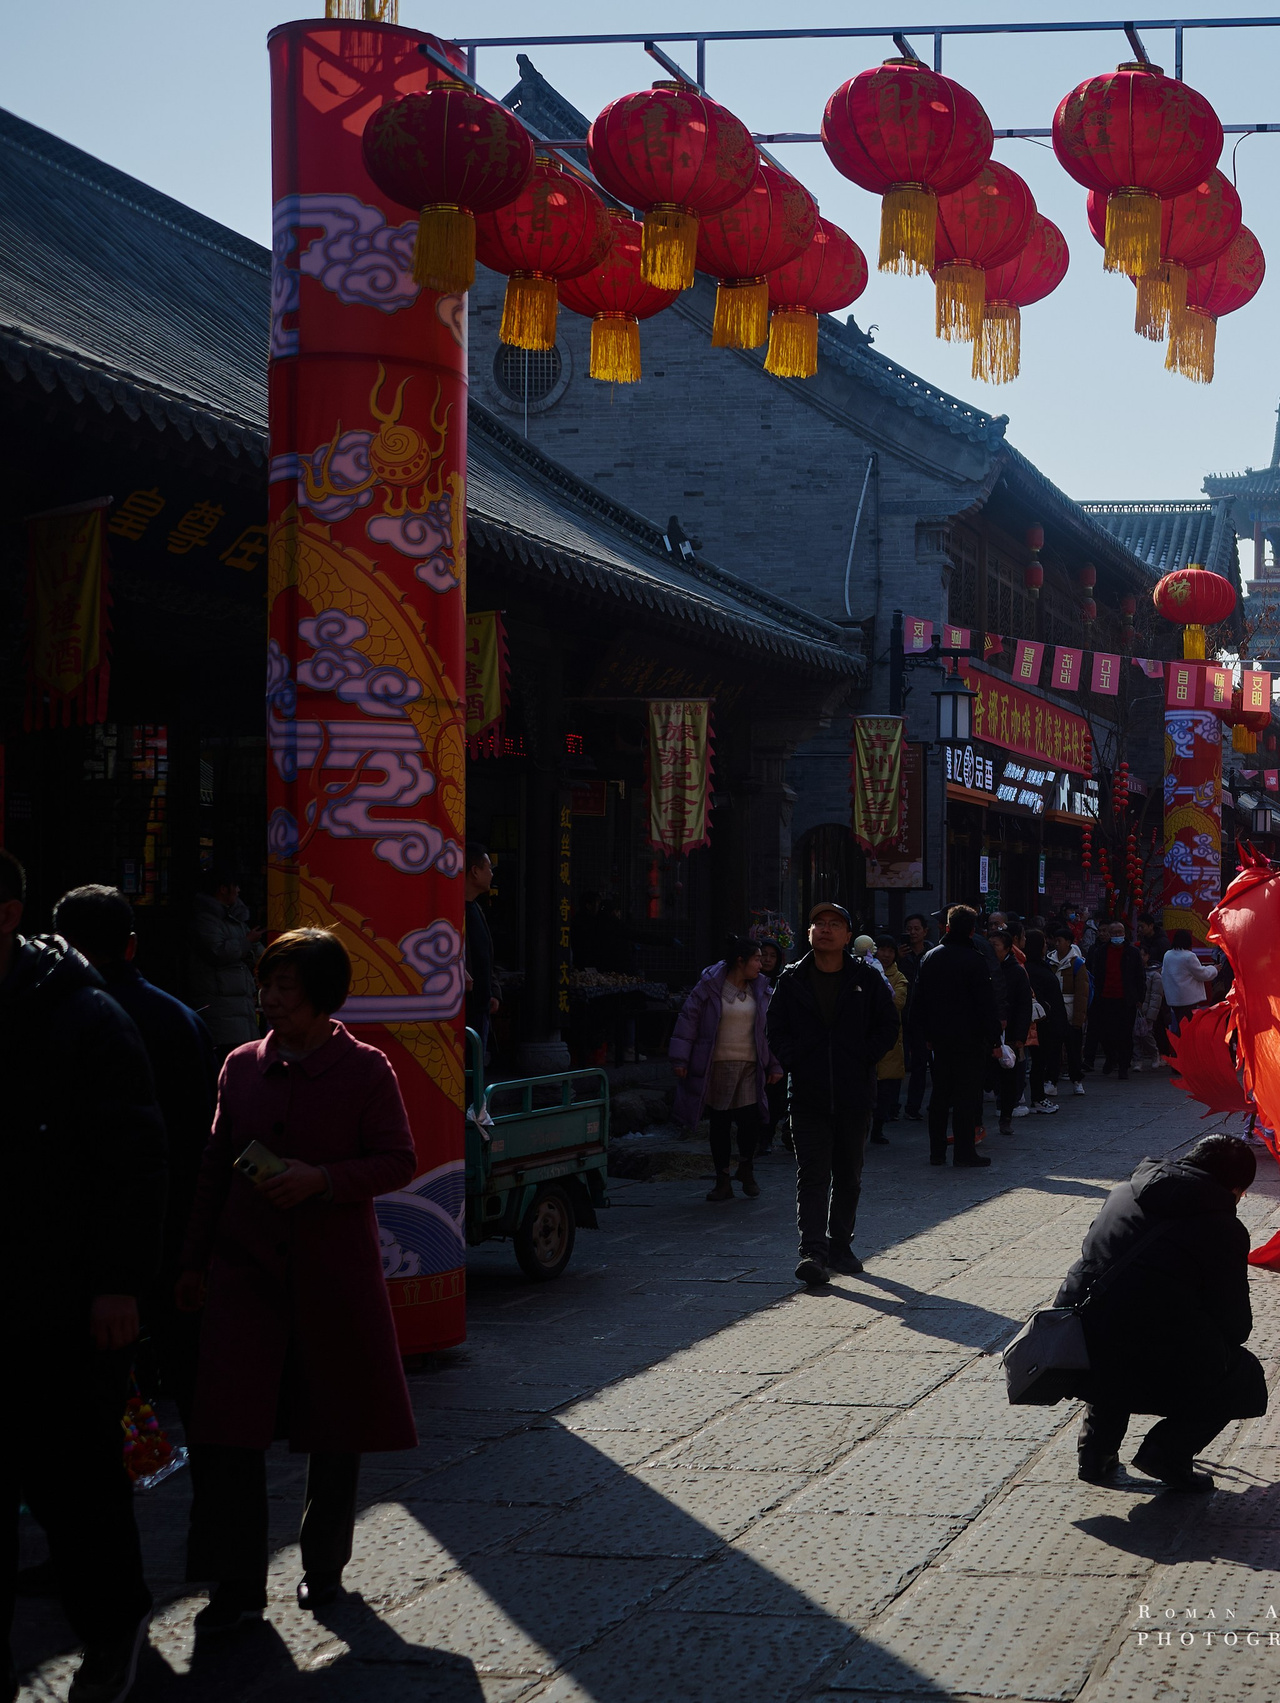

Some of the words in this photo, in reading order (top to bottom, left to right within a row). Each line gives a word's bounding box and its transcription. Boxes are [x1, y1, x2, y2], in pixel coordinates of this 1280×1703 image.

[876, 83, 921, 131] 財
[46, 551, 82, 678] 山楂酒
[656, 721, 700, 839] 旅游纪念品
[859, 733, 896, 837] 青州红丝砚
